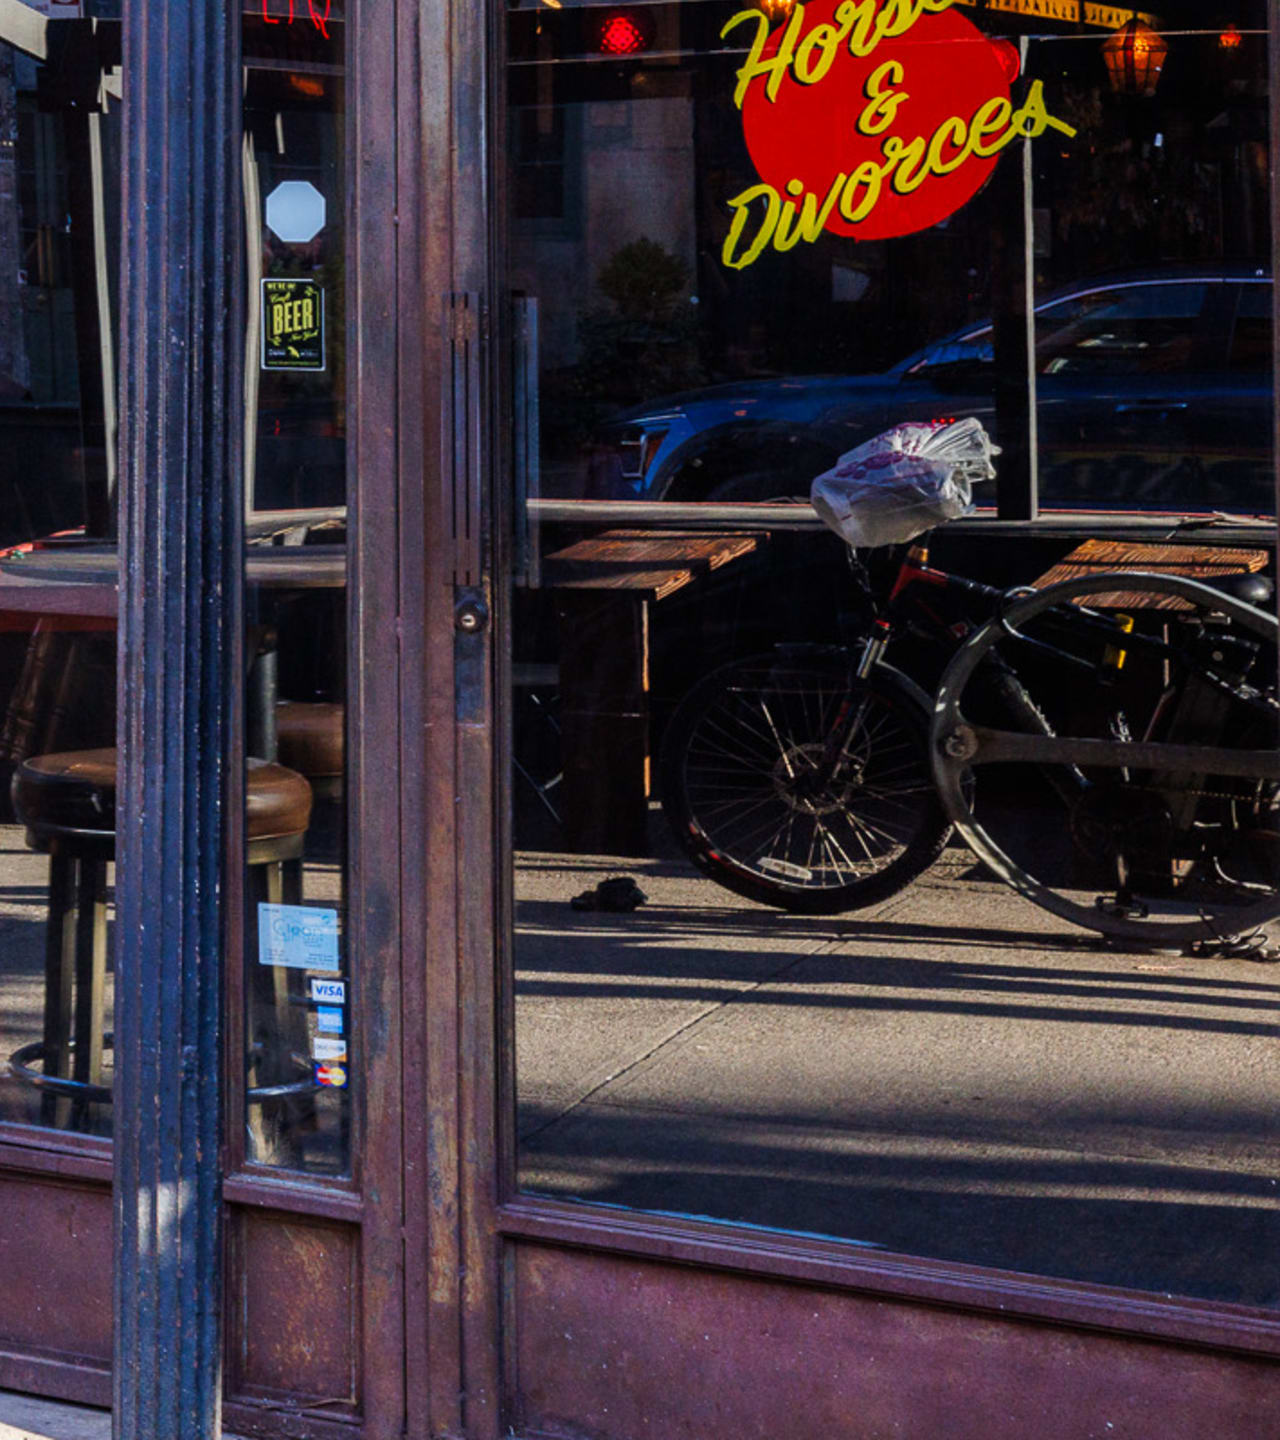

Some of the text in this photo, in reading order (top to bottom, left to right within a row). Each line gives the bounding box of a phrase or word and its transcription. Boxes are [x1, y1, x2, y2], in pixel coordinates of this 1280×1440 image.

[858, 59, 910, 136] &
[721, 79, 1077, 270] Divorces
[273, 298, 313, 336] BEER
[315, 984, 344, 998] VISA
